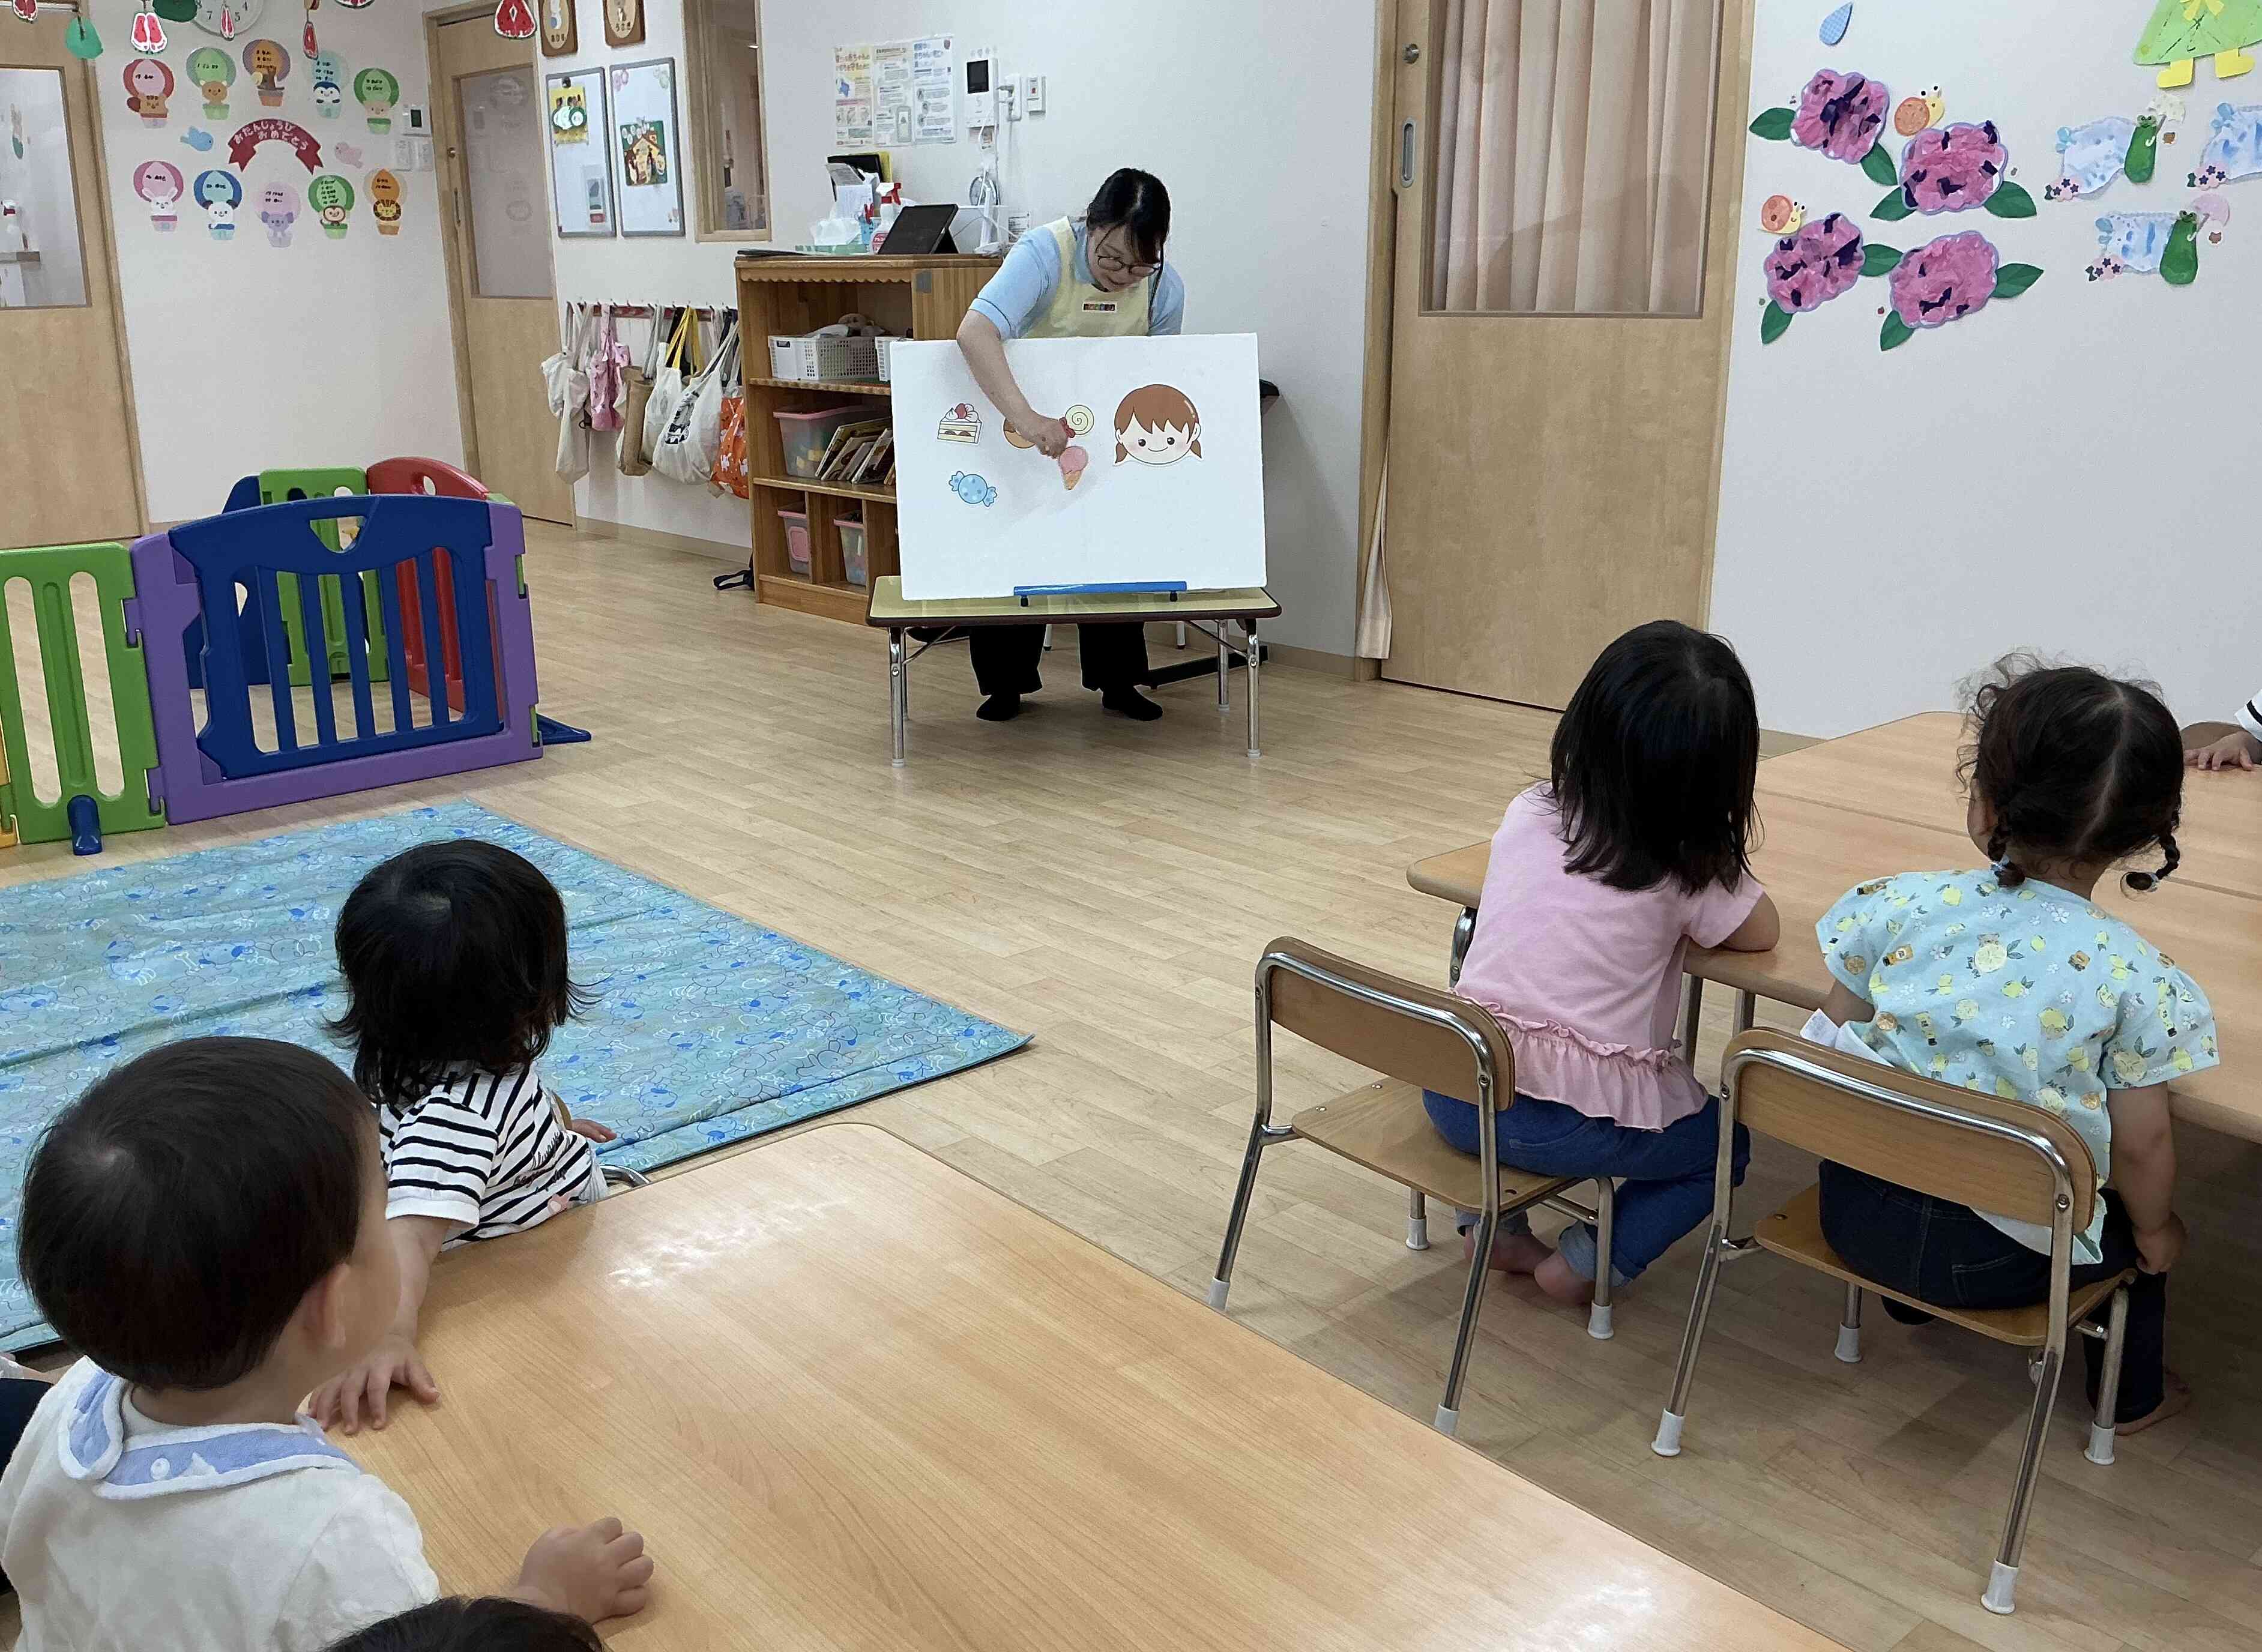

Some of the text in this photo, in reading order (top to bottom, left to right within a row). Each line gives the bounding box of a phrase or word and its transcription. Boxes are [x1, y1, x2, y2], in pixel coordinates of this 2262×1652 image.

[207, 11, 213, 20] 7
[235, 12, 241, 22] 5
[234, 121, 295, 144] おたんじょうび
[258, 130, 309, 150] おめでとう
